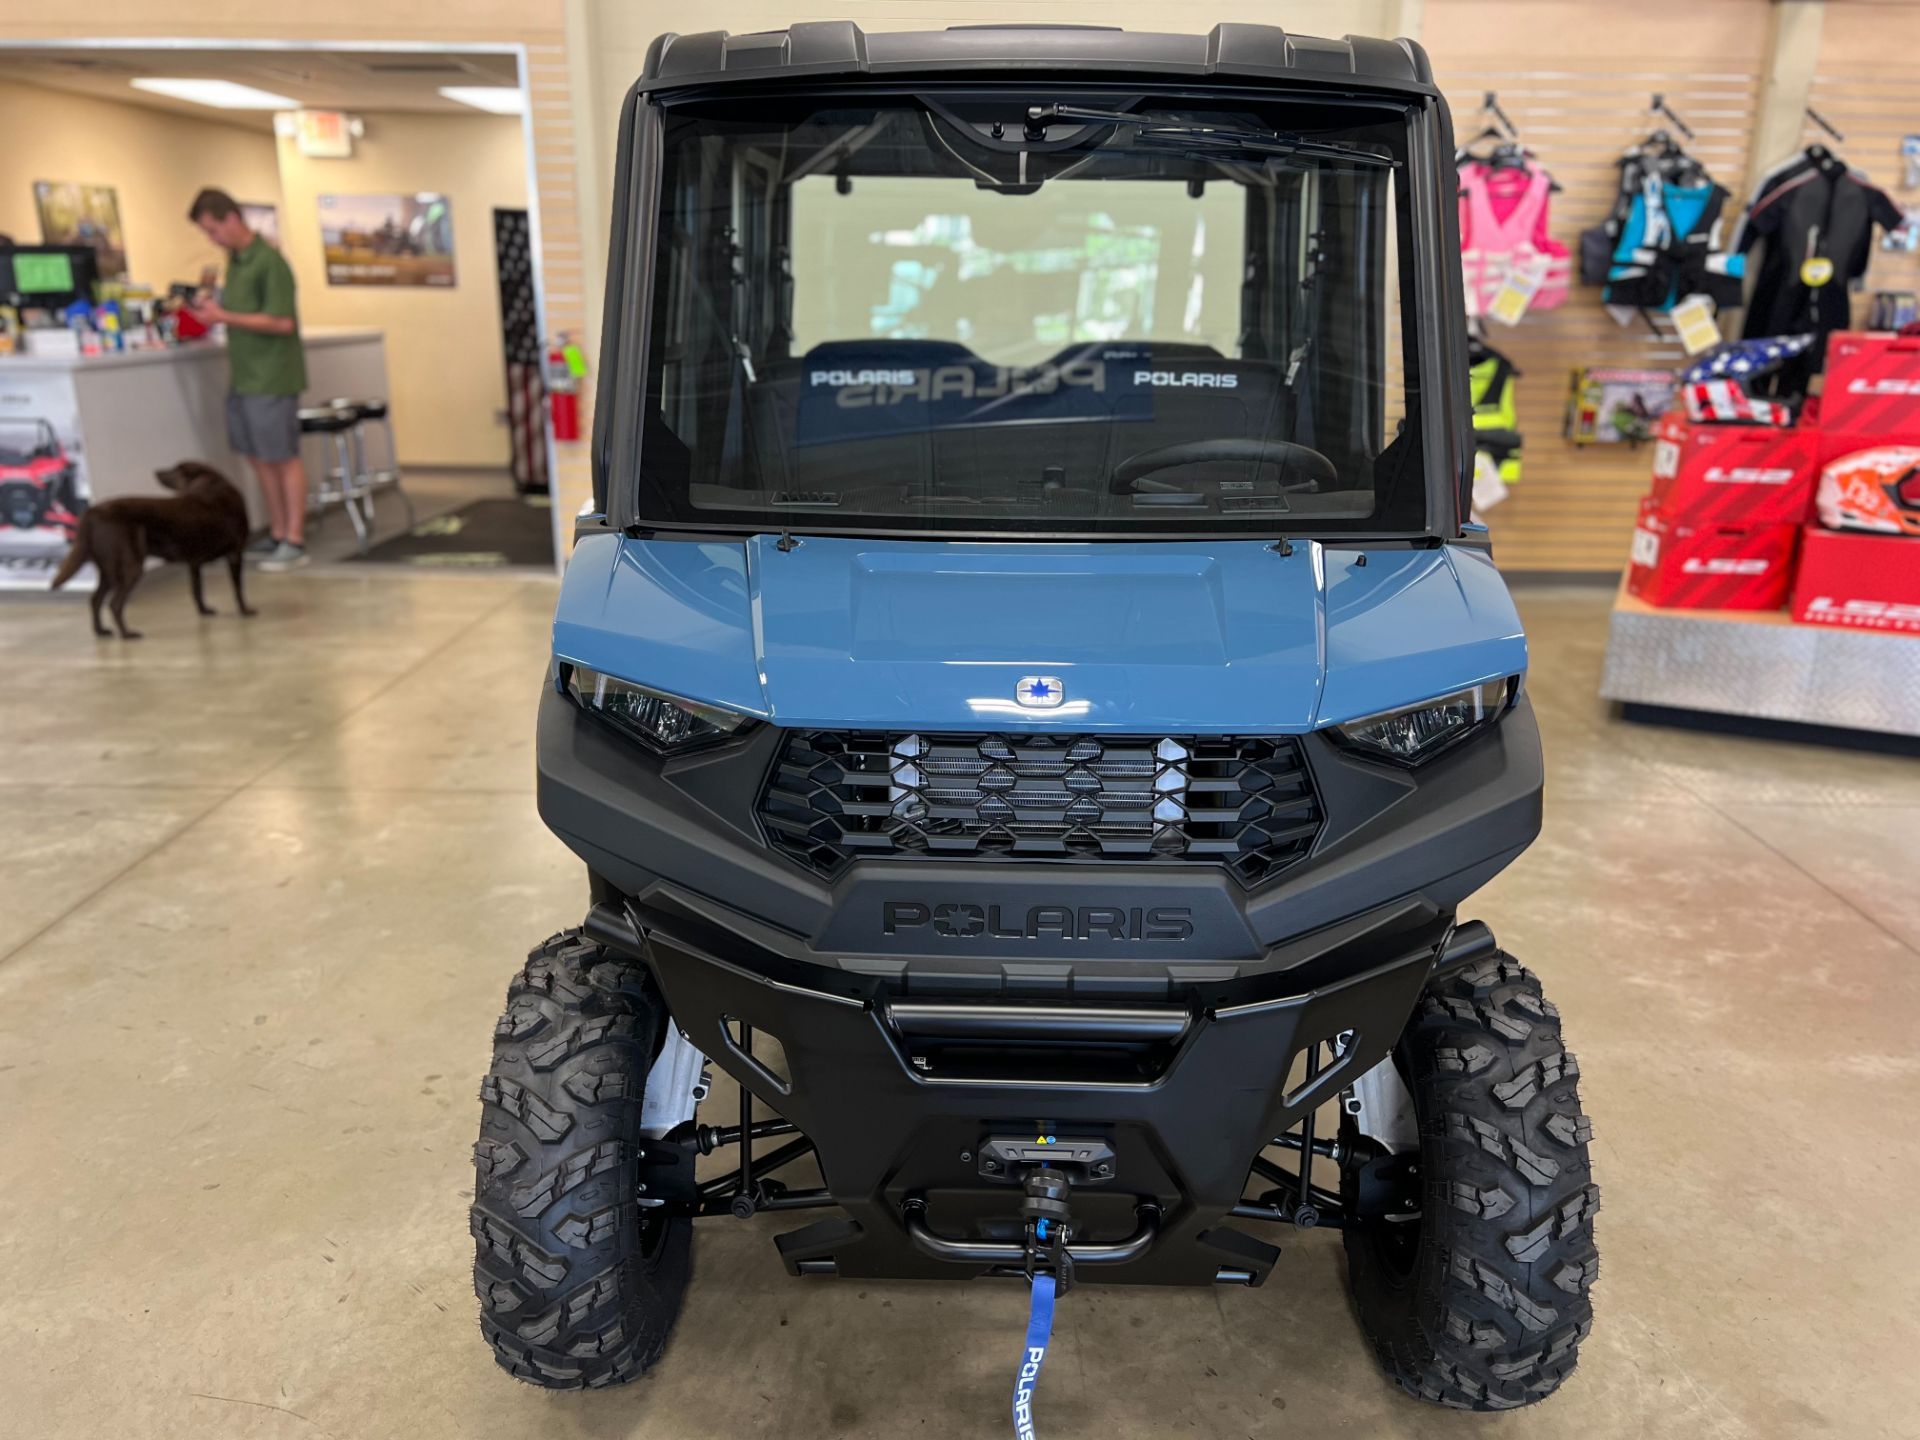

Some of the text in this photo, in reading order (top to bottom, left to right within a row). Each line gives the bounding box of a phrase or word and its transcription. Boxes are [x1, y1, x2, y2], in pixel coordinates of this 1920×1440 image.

[811, 370, 915, 387] POLARIS
[1134, 371, 1238, 388] POLARIS
[884, 902, 1194, 941] POLARIS
[1015, 1347, 1045, 1440] POLARIS
